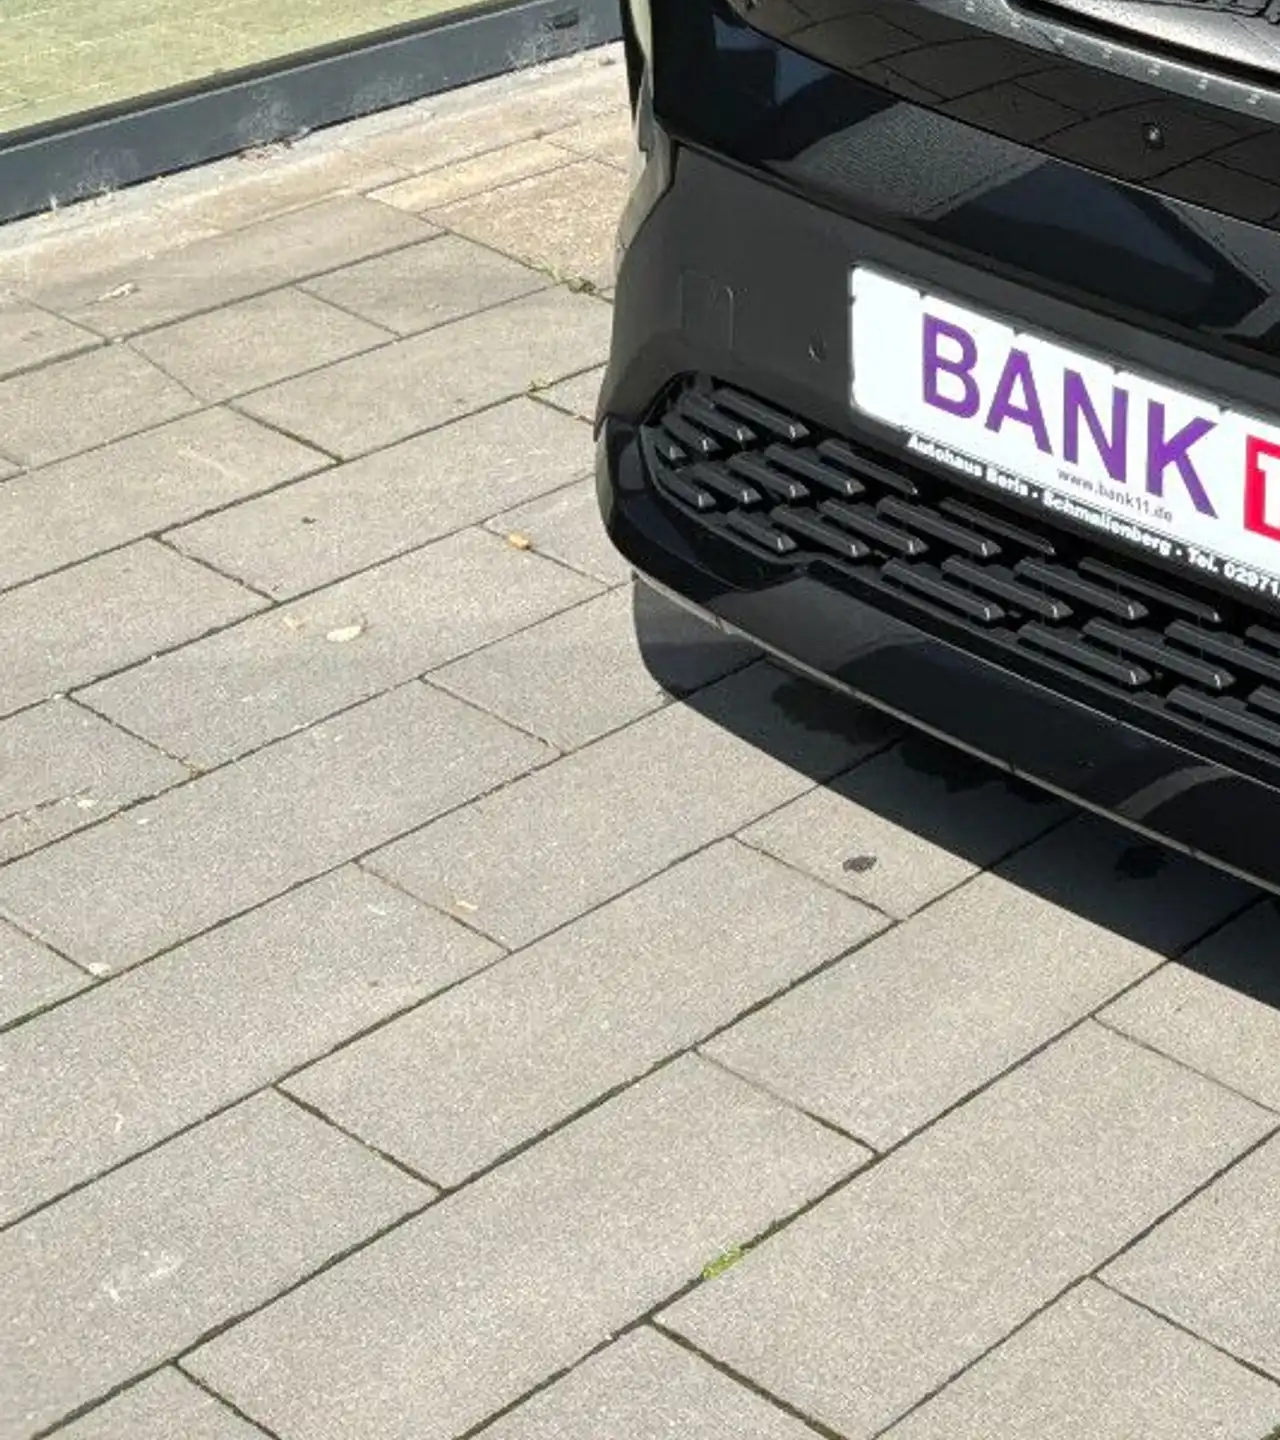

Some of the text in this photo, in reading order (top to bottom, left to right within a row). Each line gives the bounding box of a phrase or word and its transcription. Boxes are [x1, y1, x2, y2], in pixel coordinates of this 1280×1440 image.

[923, 312, 1219, 519] BANK
[907, 434, 983, 478] Autohaus
[986, 468, 1029, 497] Berls
[1042, 488, 1171, 557] Schmallenberg
[1188, 546, 1219, 573] Tel.
[1057, 468, 1173, 522] www.bank11.de
